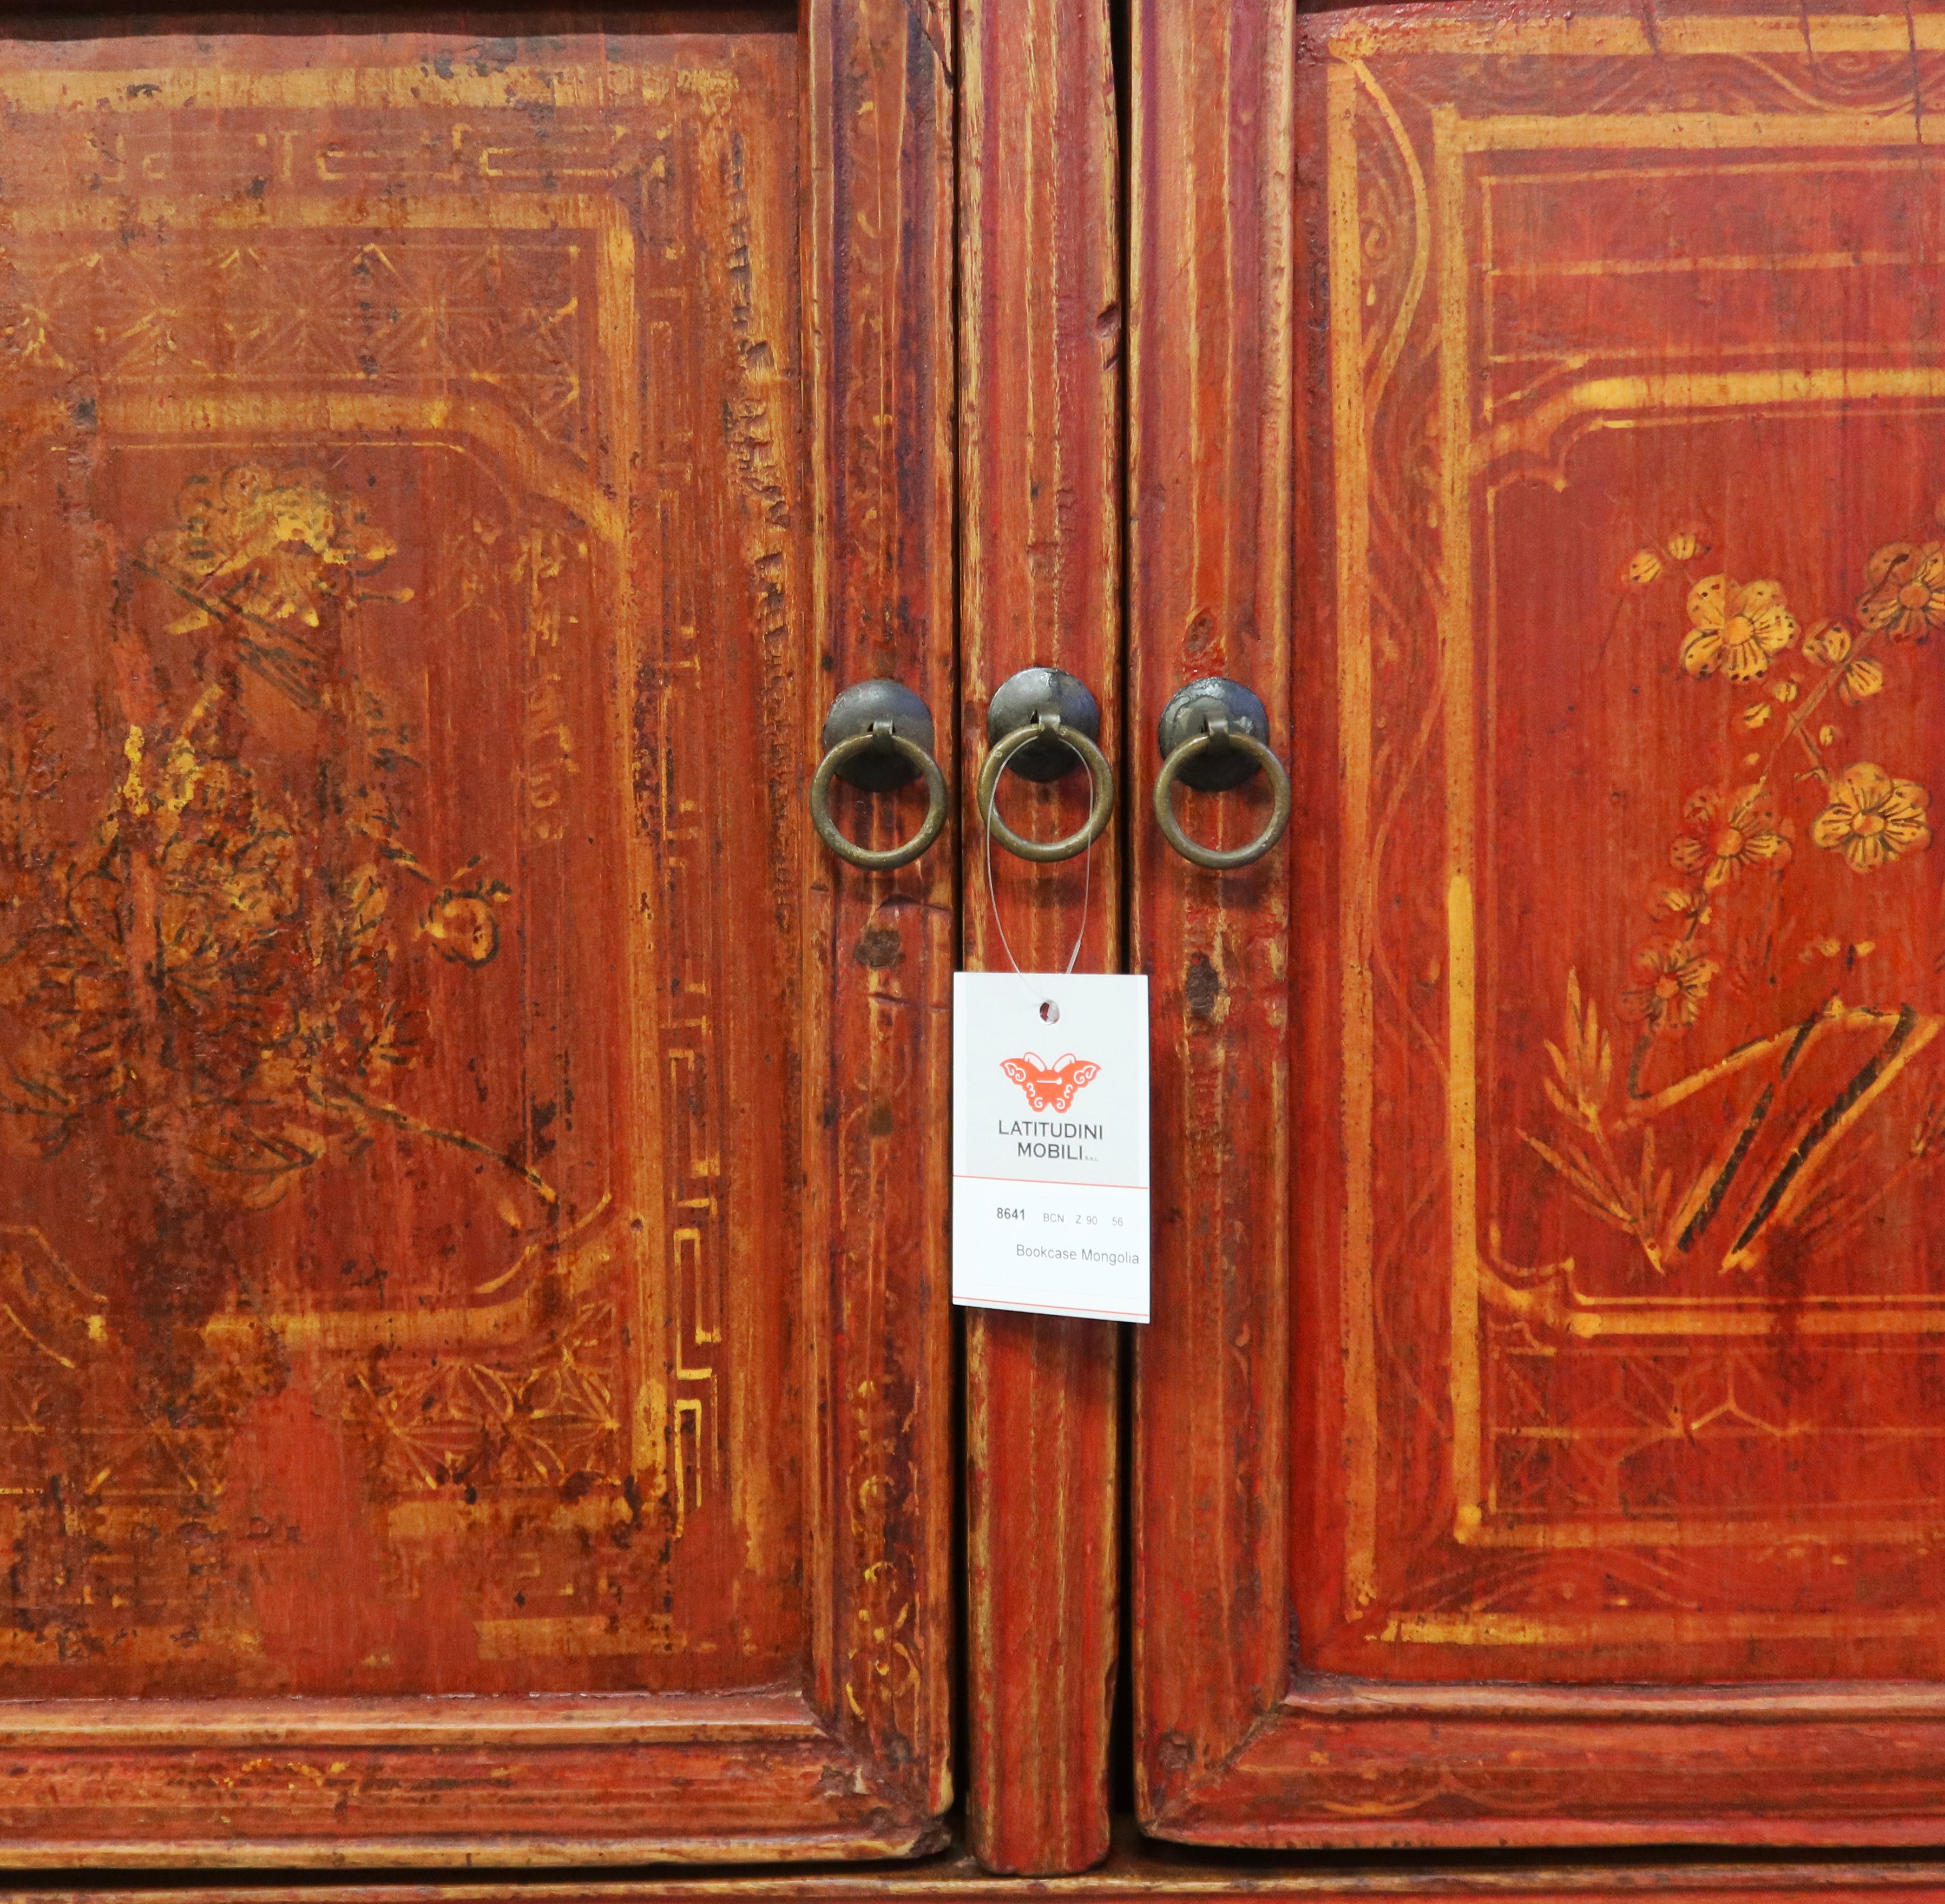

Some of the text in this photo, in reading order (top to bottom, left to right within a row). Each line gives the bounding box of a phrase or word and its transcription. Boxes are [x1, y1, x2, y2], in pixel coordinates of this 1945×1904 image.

[998, 1120, 1103, 1140] LATITUDINI
[1017, 1142, 1083, 1161] MOBILI
[997, 1207, 1123, 1226] 8641 BCN Z 90 56
[1016, 1244, 1139, 1266] Bookcase Mongolia
